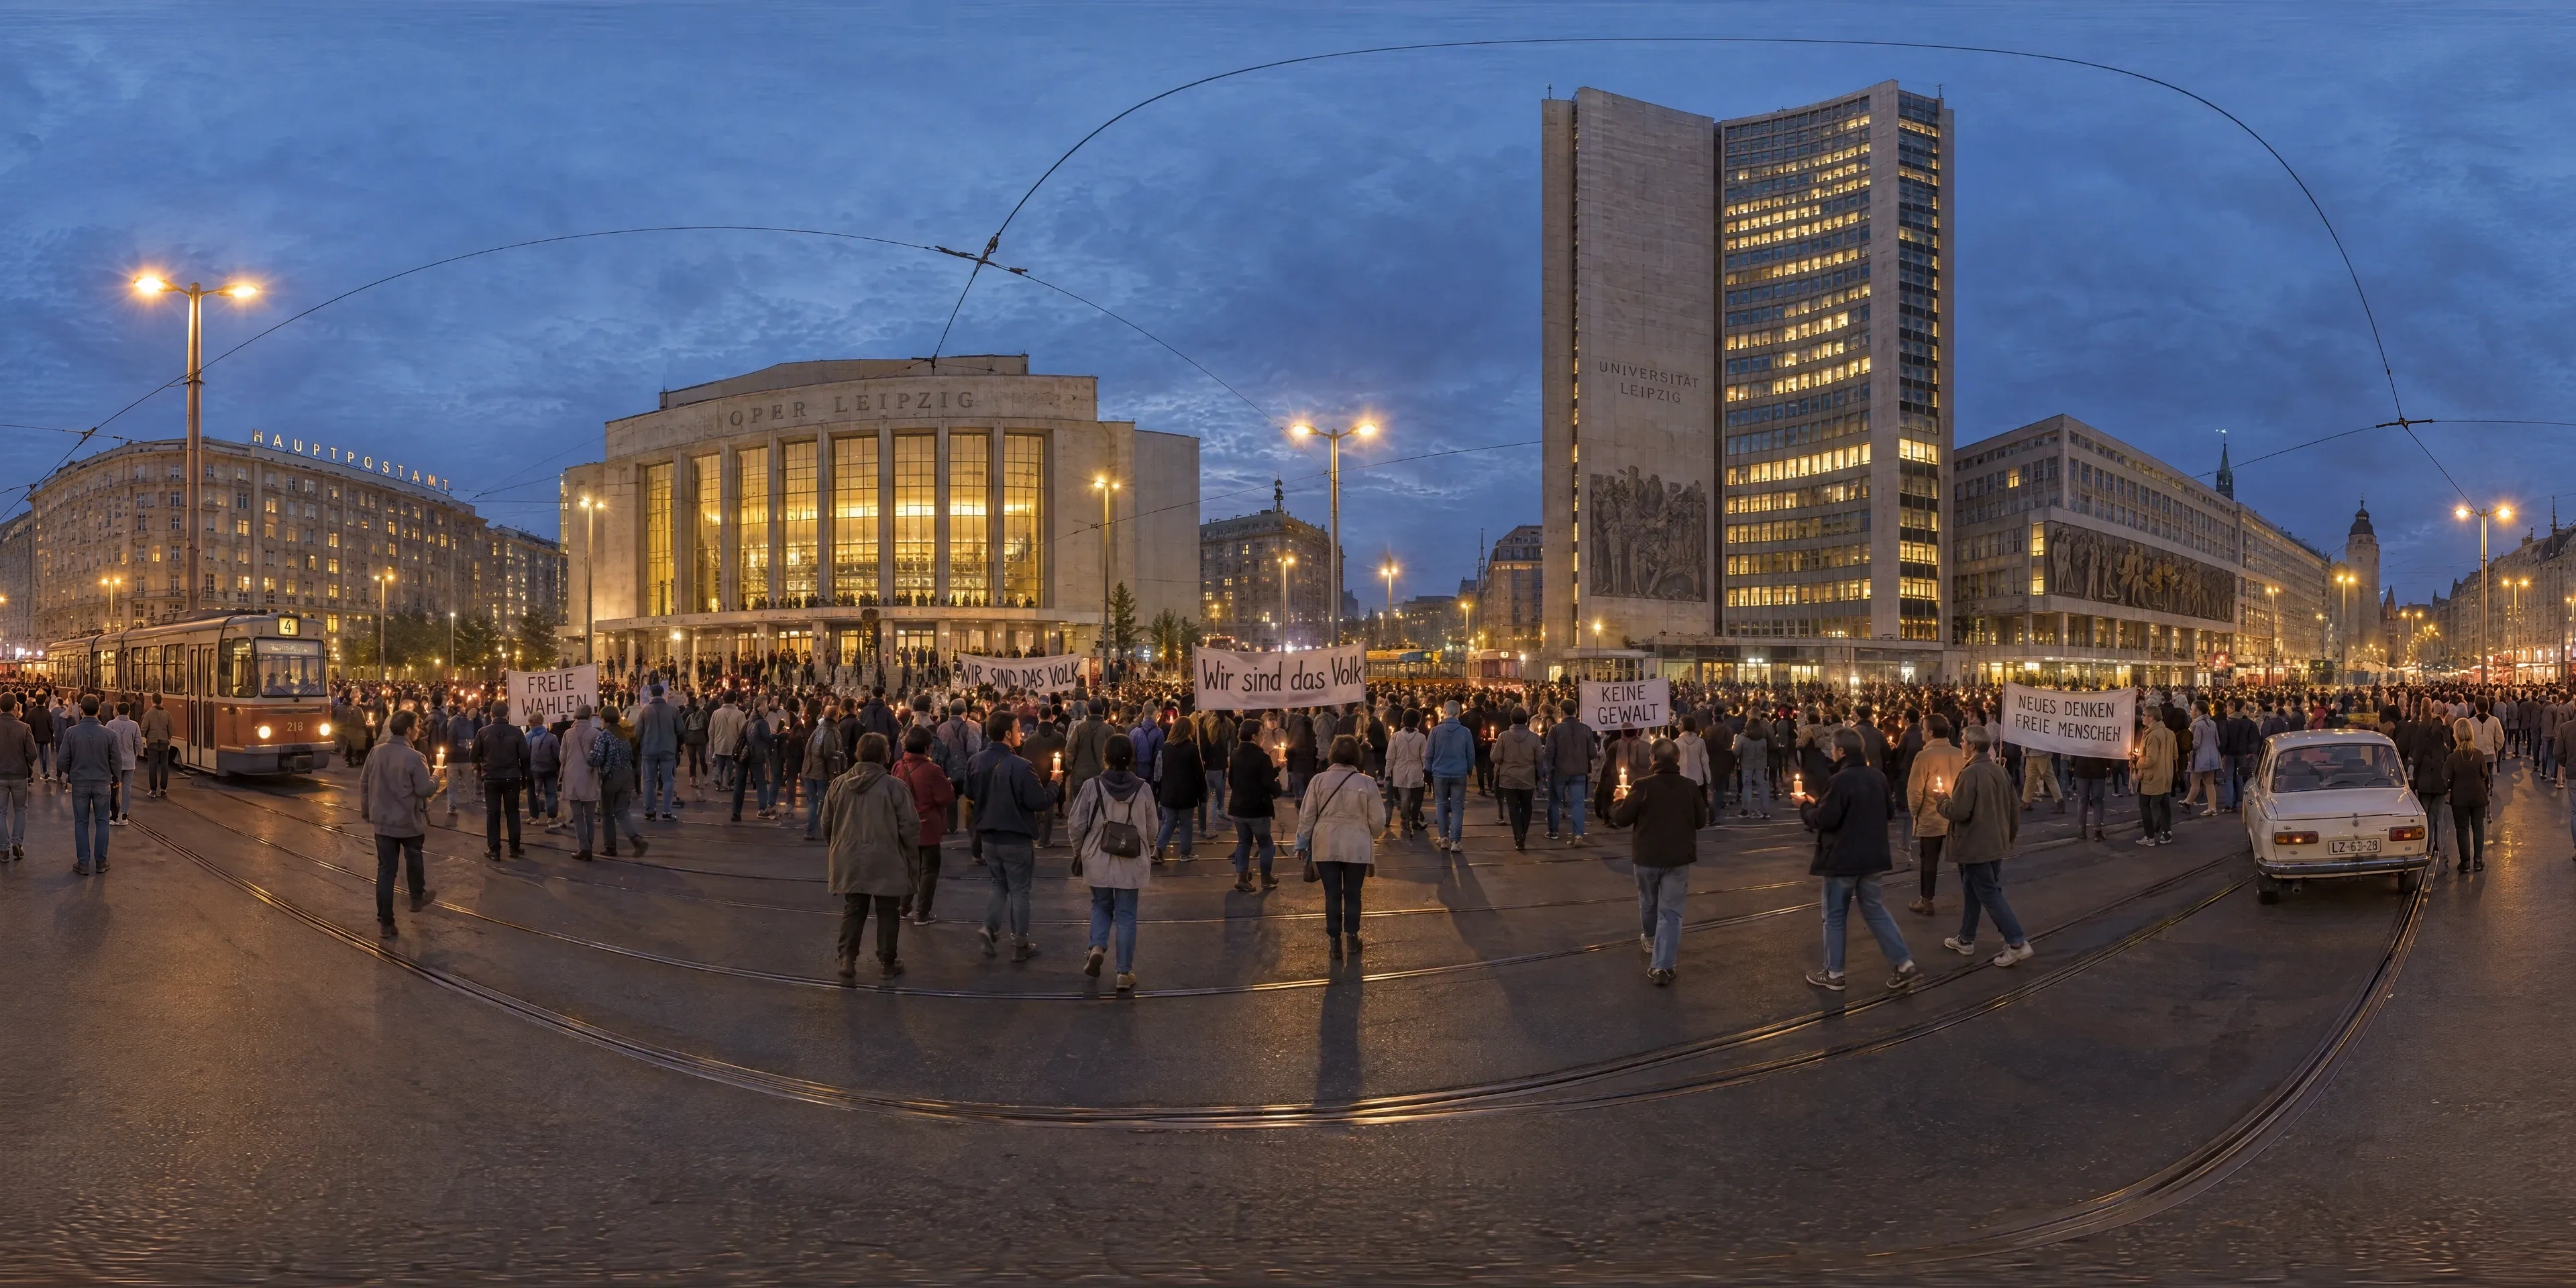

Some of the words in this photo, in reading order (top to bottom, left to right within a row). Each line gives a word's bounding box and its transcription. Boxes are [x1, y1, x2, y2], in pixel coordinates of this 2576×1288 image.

[1599, 360, 1699, 388] UNIVERSITÄT
[1620, 382, 1681, 403] LEIPZIG
[729, 402, 806, 427] OPER
[834, 392, 974, 413] LEIPZIG
[284, 619, 292, 633] 4
[528, 673, 575, 694] FREIE
[961, 663, 982, 686] WIR
[990, 667, 1017, 689] SIND
[1022, 668, 1044, 690] DAS
[1048, 661, 1080, 689] VOLK
[1202, 659, 1234, 690] Wir
[1242, 661, 1282, 692] sind
[1290, 659, 1326, 691] das
[1330, 655, 1362, 687] Volk
[1601, 684, 1646, 702] KEINE
[1597, 703, 1659, 725] GEWALT
[2019, 694, 2057, 714] NEUES
[2064, 701, 2115, 718] DENKEN
[286, 721, 303, 733] 218
[2015, 713, 2050, 735] FREIE
